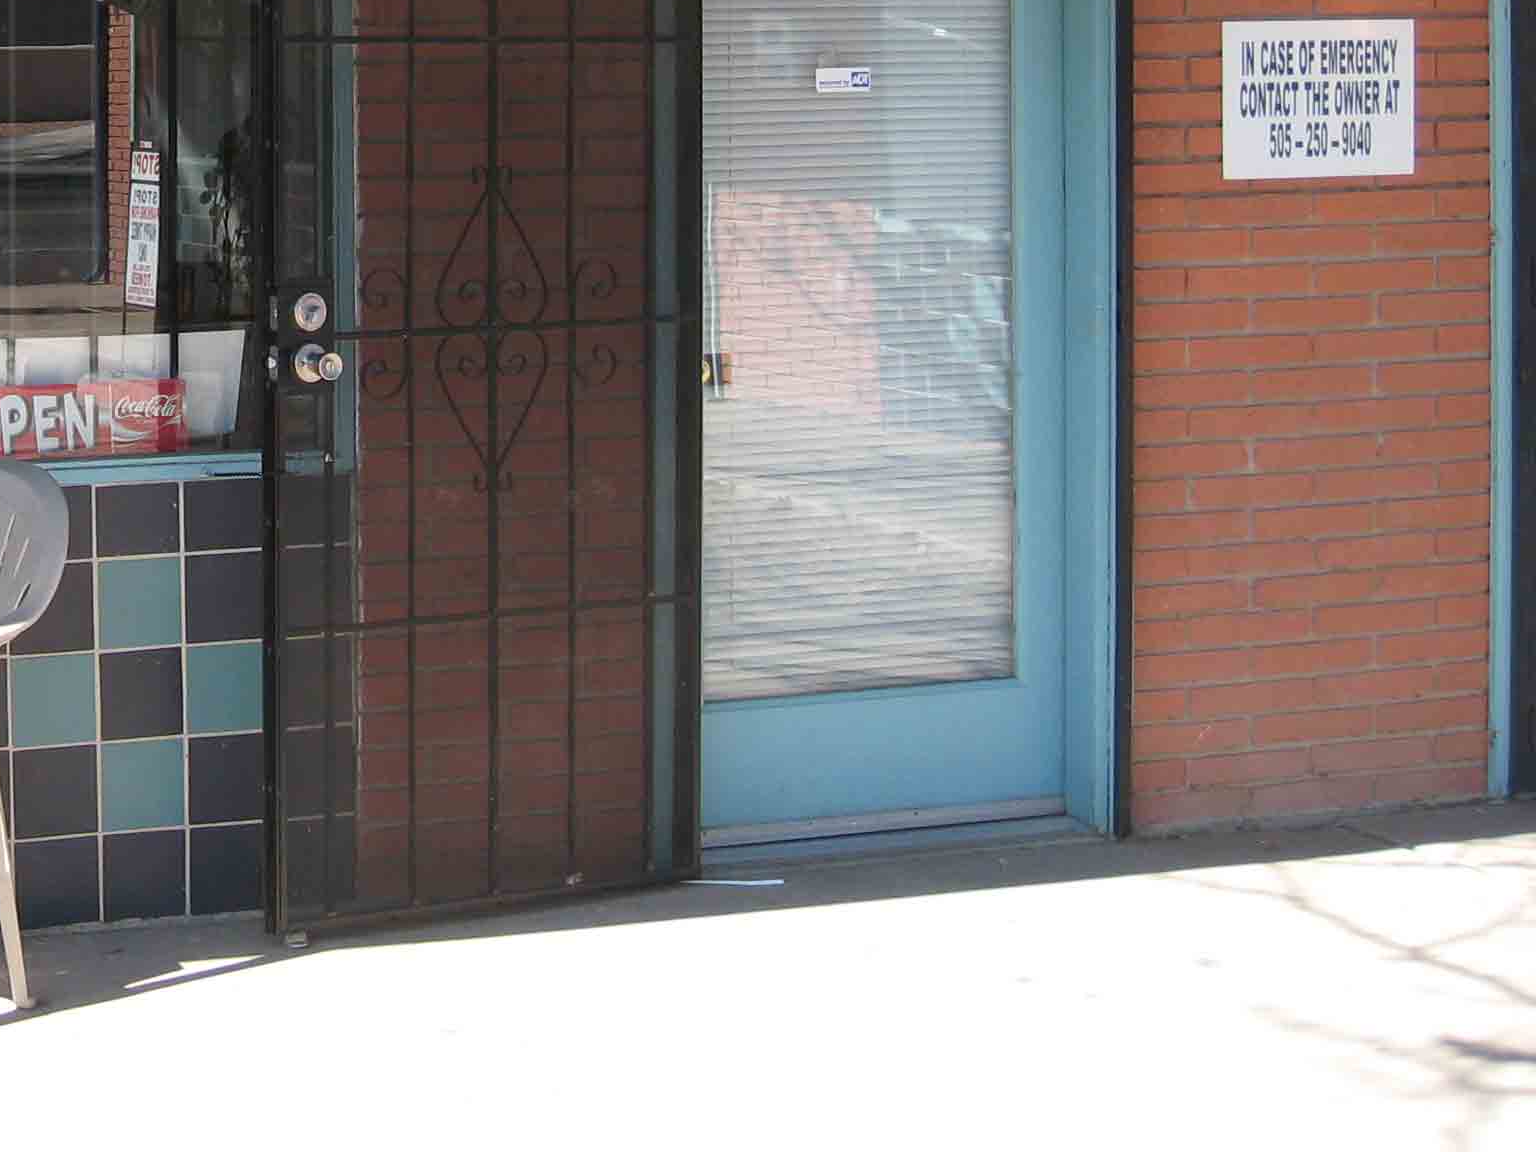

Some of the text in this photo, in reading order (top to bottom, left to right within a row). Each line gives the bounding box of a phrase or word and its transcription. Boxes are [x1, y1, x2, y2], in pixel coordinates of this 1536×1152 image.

[1241, 39, 1398, 76] IN CASE OF EMERGENCY
[1239, 79, 1400, 118] CONTACT THE OWNER AT
